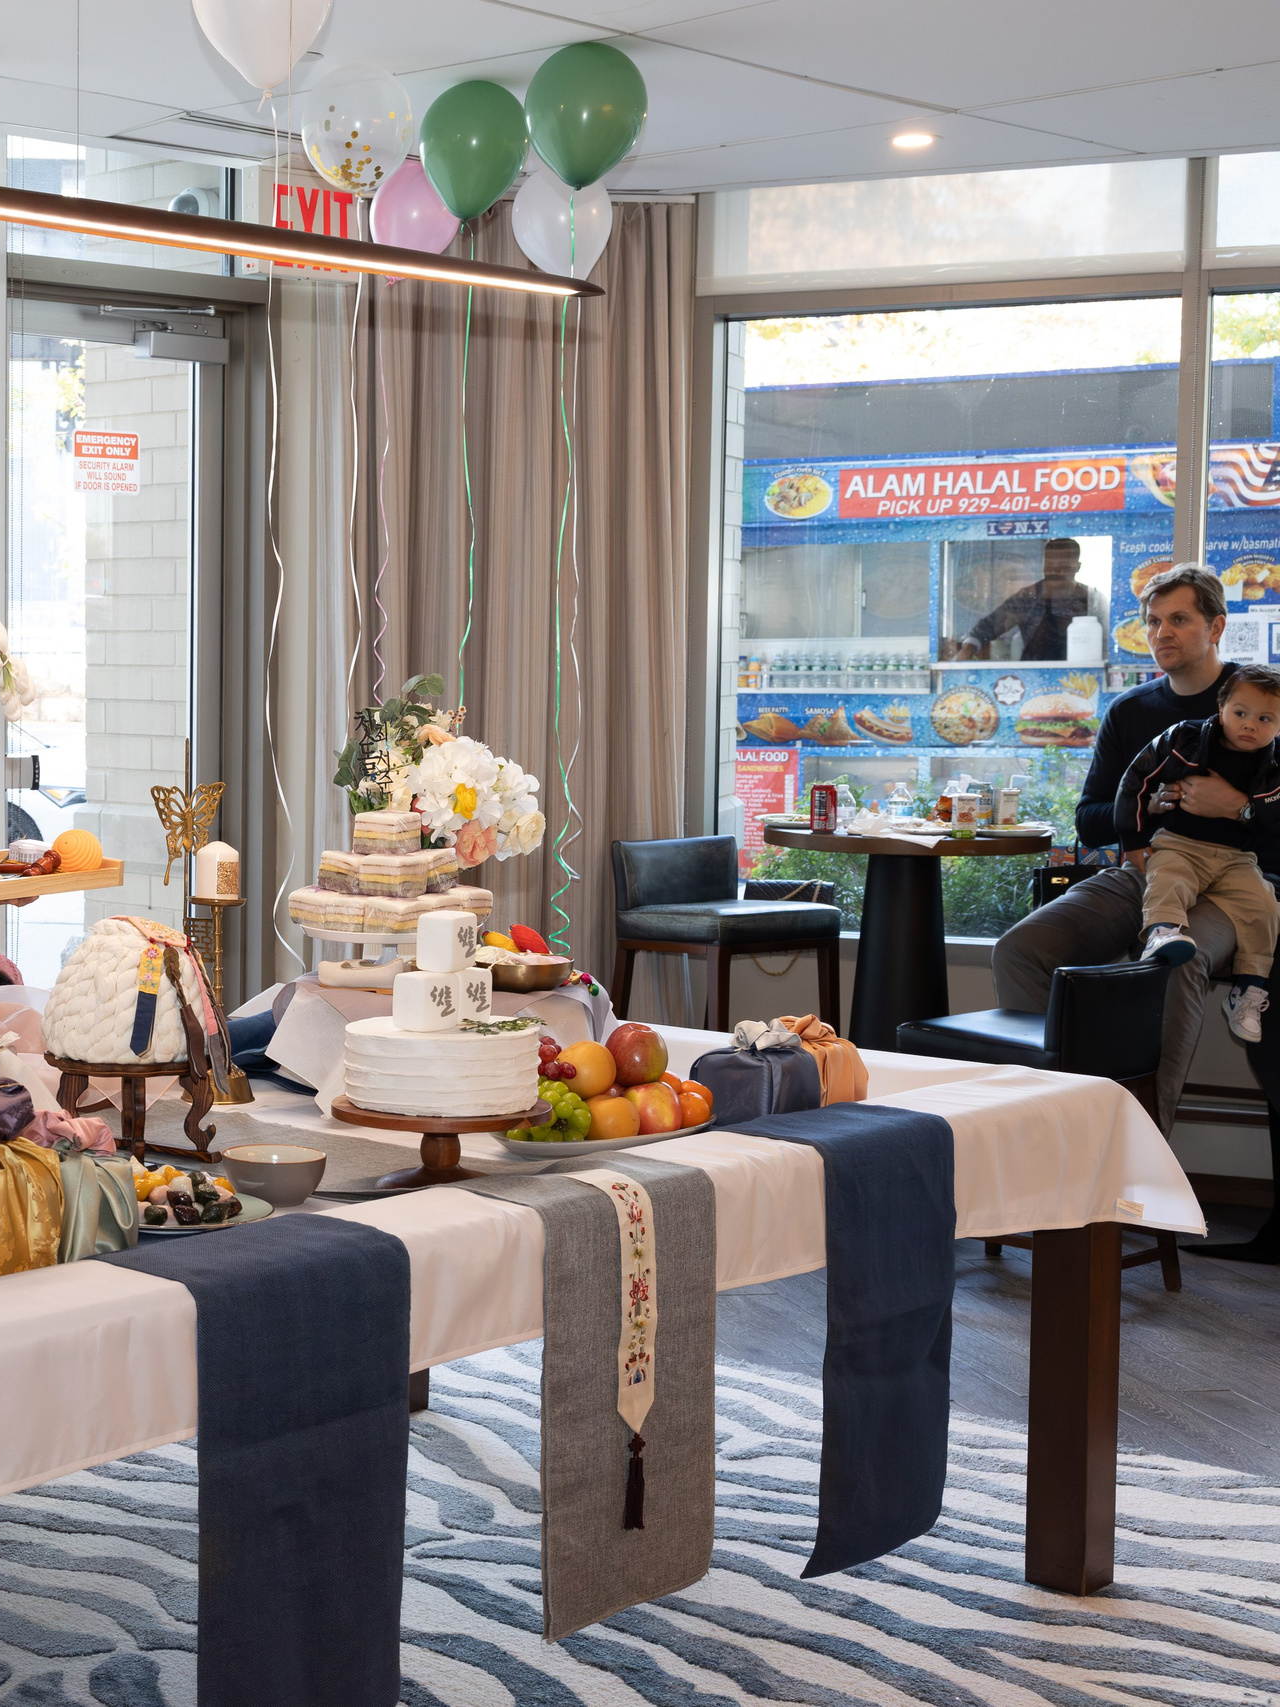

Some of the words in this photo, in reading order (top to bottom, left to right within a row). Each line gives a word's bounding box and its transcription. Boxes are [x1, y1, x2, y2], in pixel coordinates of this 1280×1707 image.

[273, 183, 353, 273] EXIT
[76, 434, 137, 446] EMERGENCY
[82, 445, 103, 455] EXIT
[106, 446, 131, 456] ONLY
[79, 461, 111, 470] SECURITY
[112, 462, 135, 471] ALARM
[87, 471, 102, 480] WILL
[104, 472, 127, 481] SOUND
[75, 481, 82, 490] IF
[83, 481, 102, 490] DOOR
[104, 482, 110, 491] IS
[111, 482, 138, 492] OPENED
[844, 473, 926, 499] ALAM
[933, 469, 1028, 496] HALAL
[1034, 466, 1121, 492] FOOD
[877, 499, 922, 516] PICK
[926, 498, 953, 514] UP
[958, 494, 1082, 513] 929-401-6189
[1120, 541, 1146, 553] Fresh
[805, 707, 835, 715] SAMOSA
[760, 751, 789, 762] FOOD
